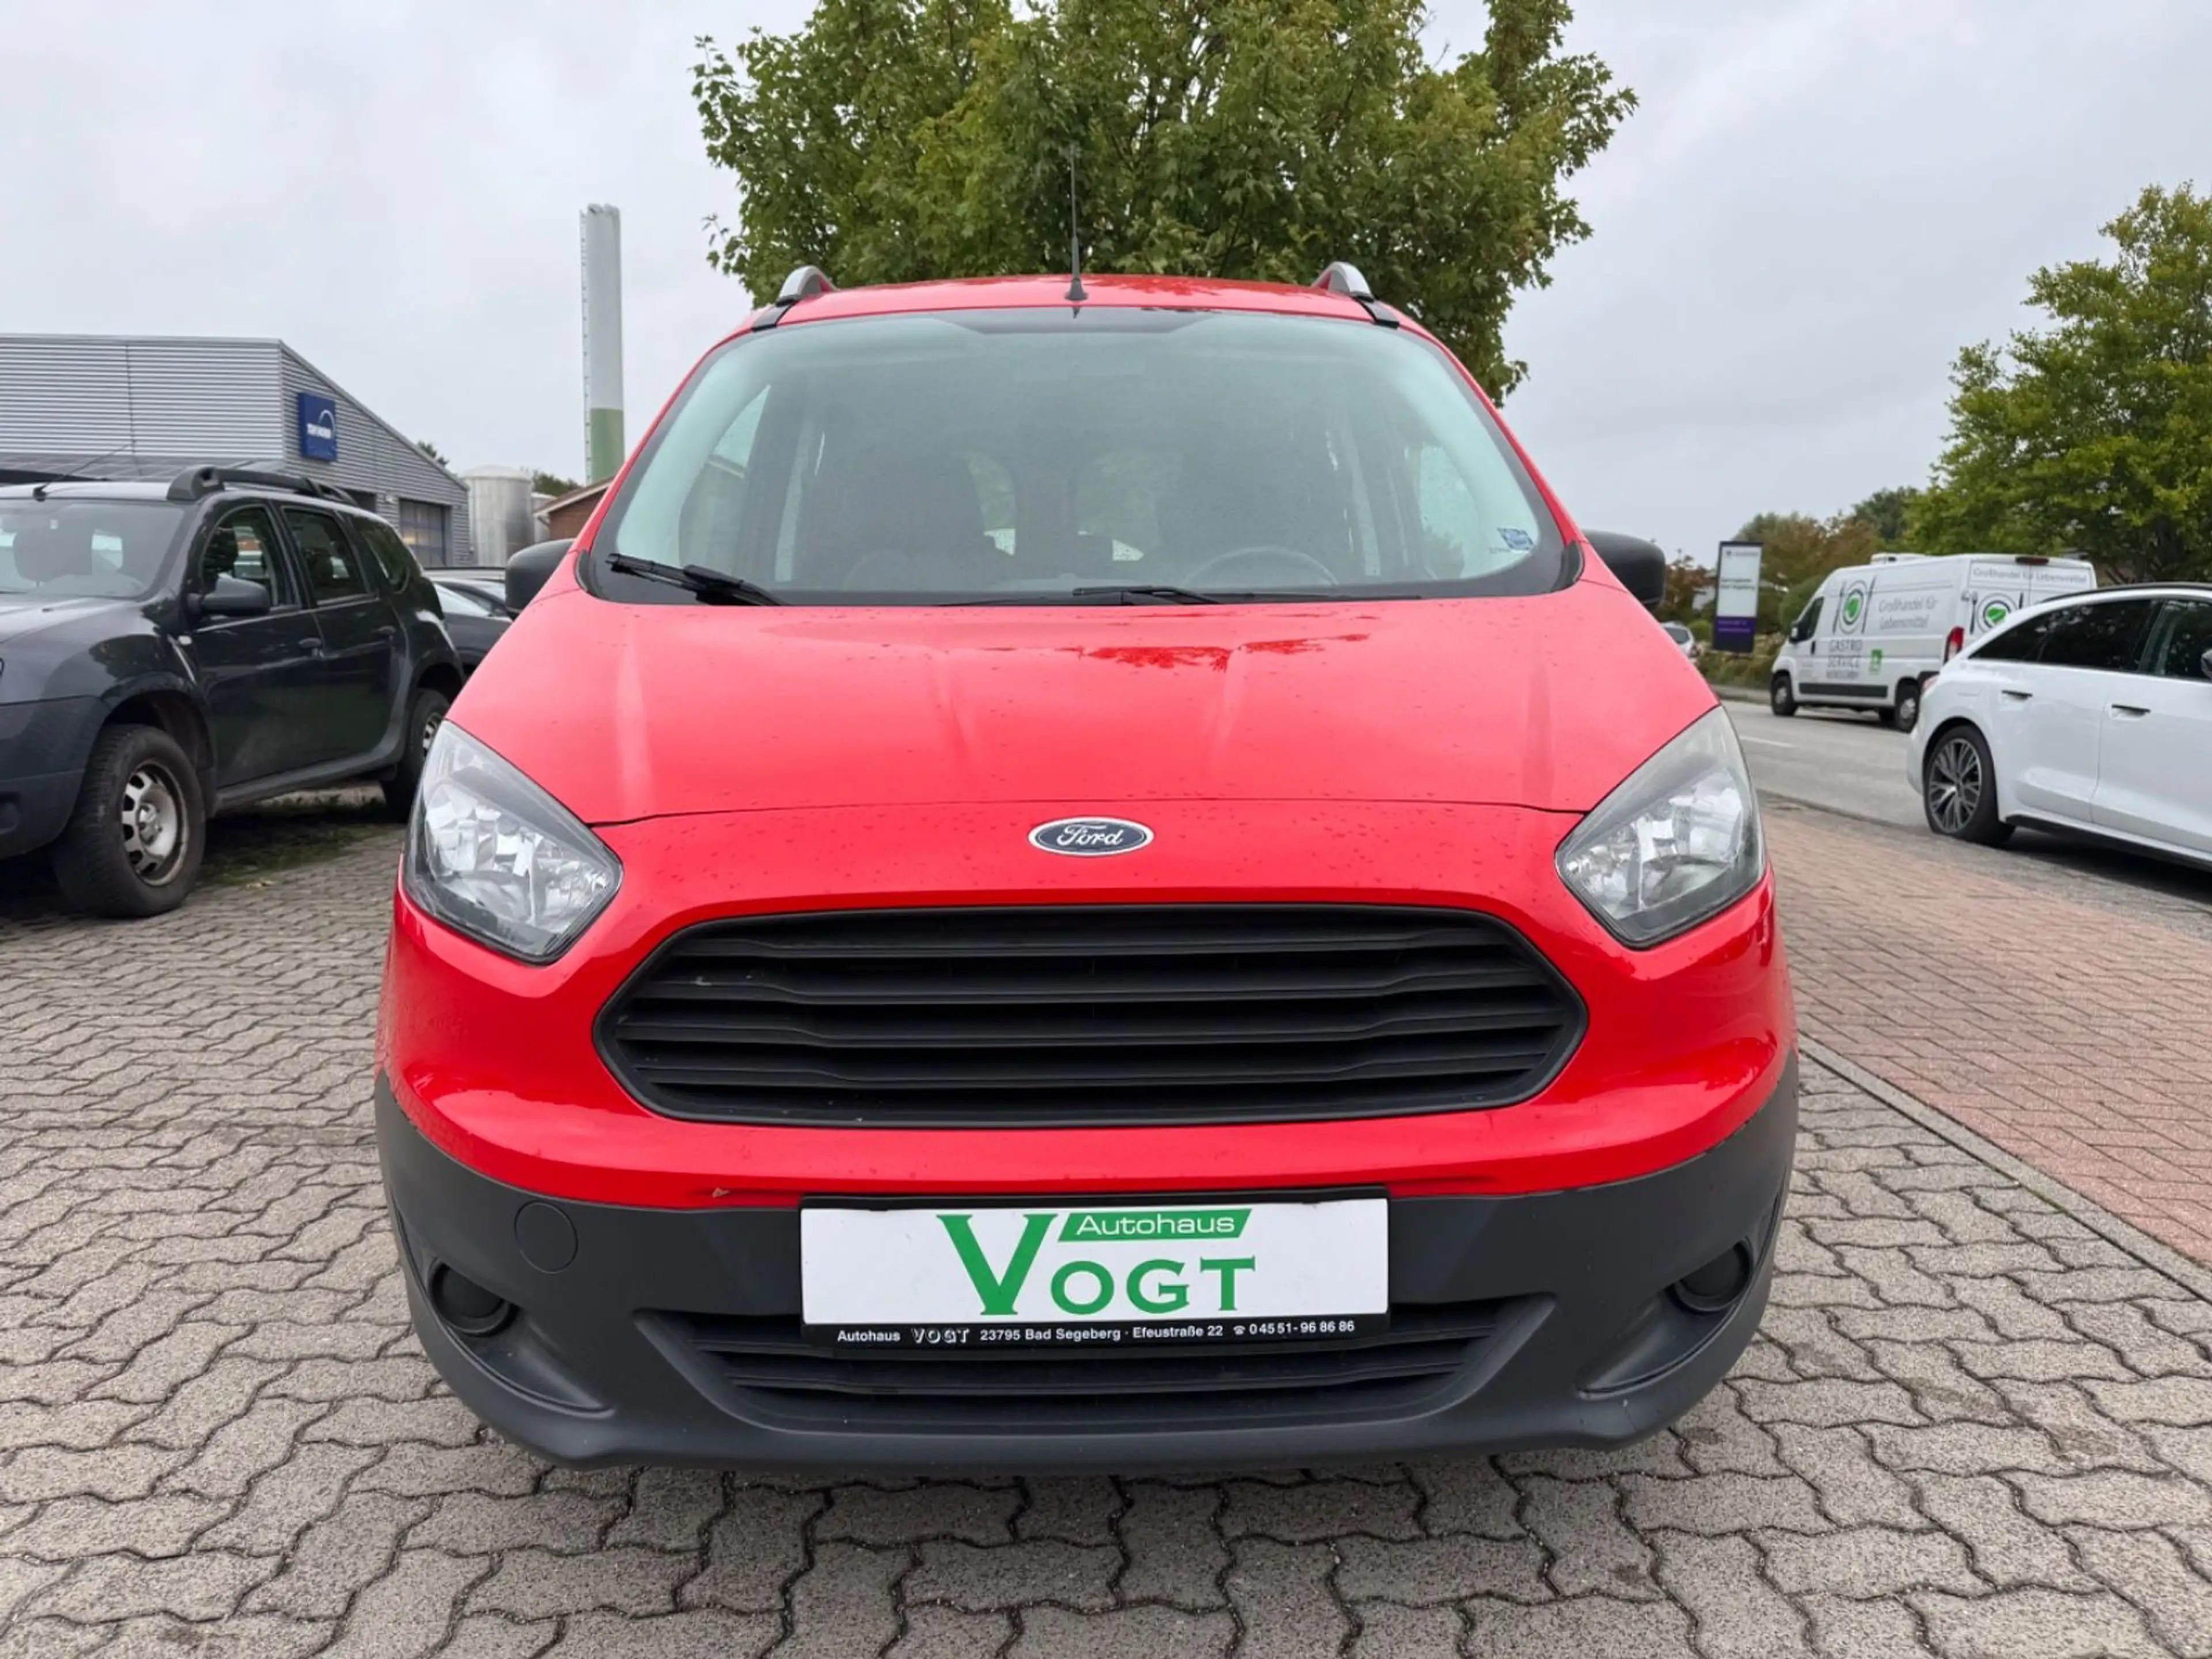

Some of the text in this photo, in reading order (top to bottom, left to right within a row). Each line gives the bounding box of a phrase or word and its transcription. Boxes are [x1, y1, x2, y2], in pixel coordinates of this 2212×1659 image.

[1829, 639, 1863, 652] GASTRO
[1056, 824, 1124, 846] Ford
[1076, 1213, 1234, 1236] Autohaus
[936, 1213, 1256, 1315] VOGT
[837, 1330, 900, 1342] Autohaus
[911, 1327, 970, 1344] VOGT
[980, 1329, 1020, 1341] 23795
[1025, 1328, 1051, 1340] Bad
[1056, 1327, 1121, 1342] Segeberg
[1132, 1325, 1204, 1338] Efeustraße
[1207, 1325, 1223, 1336] 22
[1320, 1320, 1336, 1333] 86
[1339, 1320, 1354, 1332] 86
